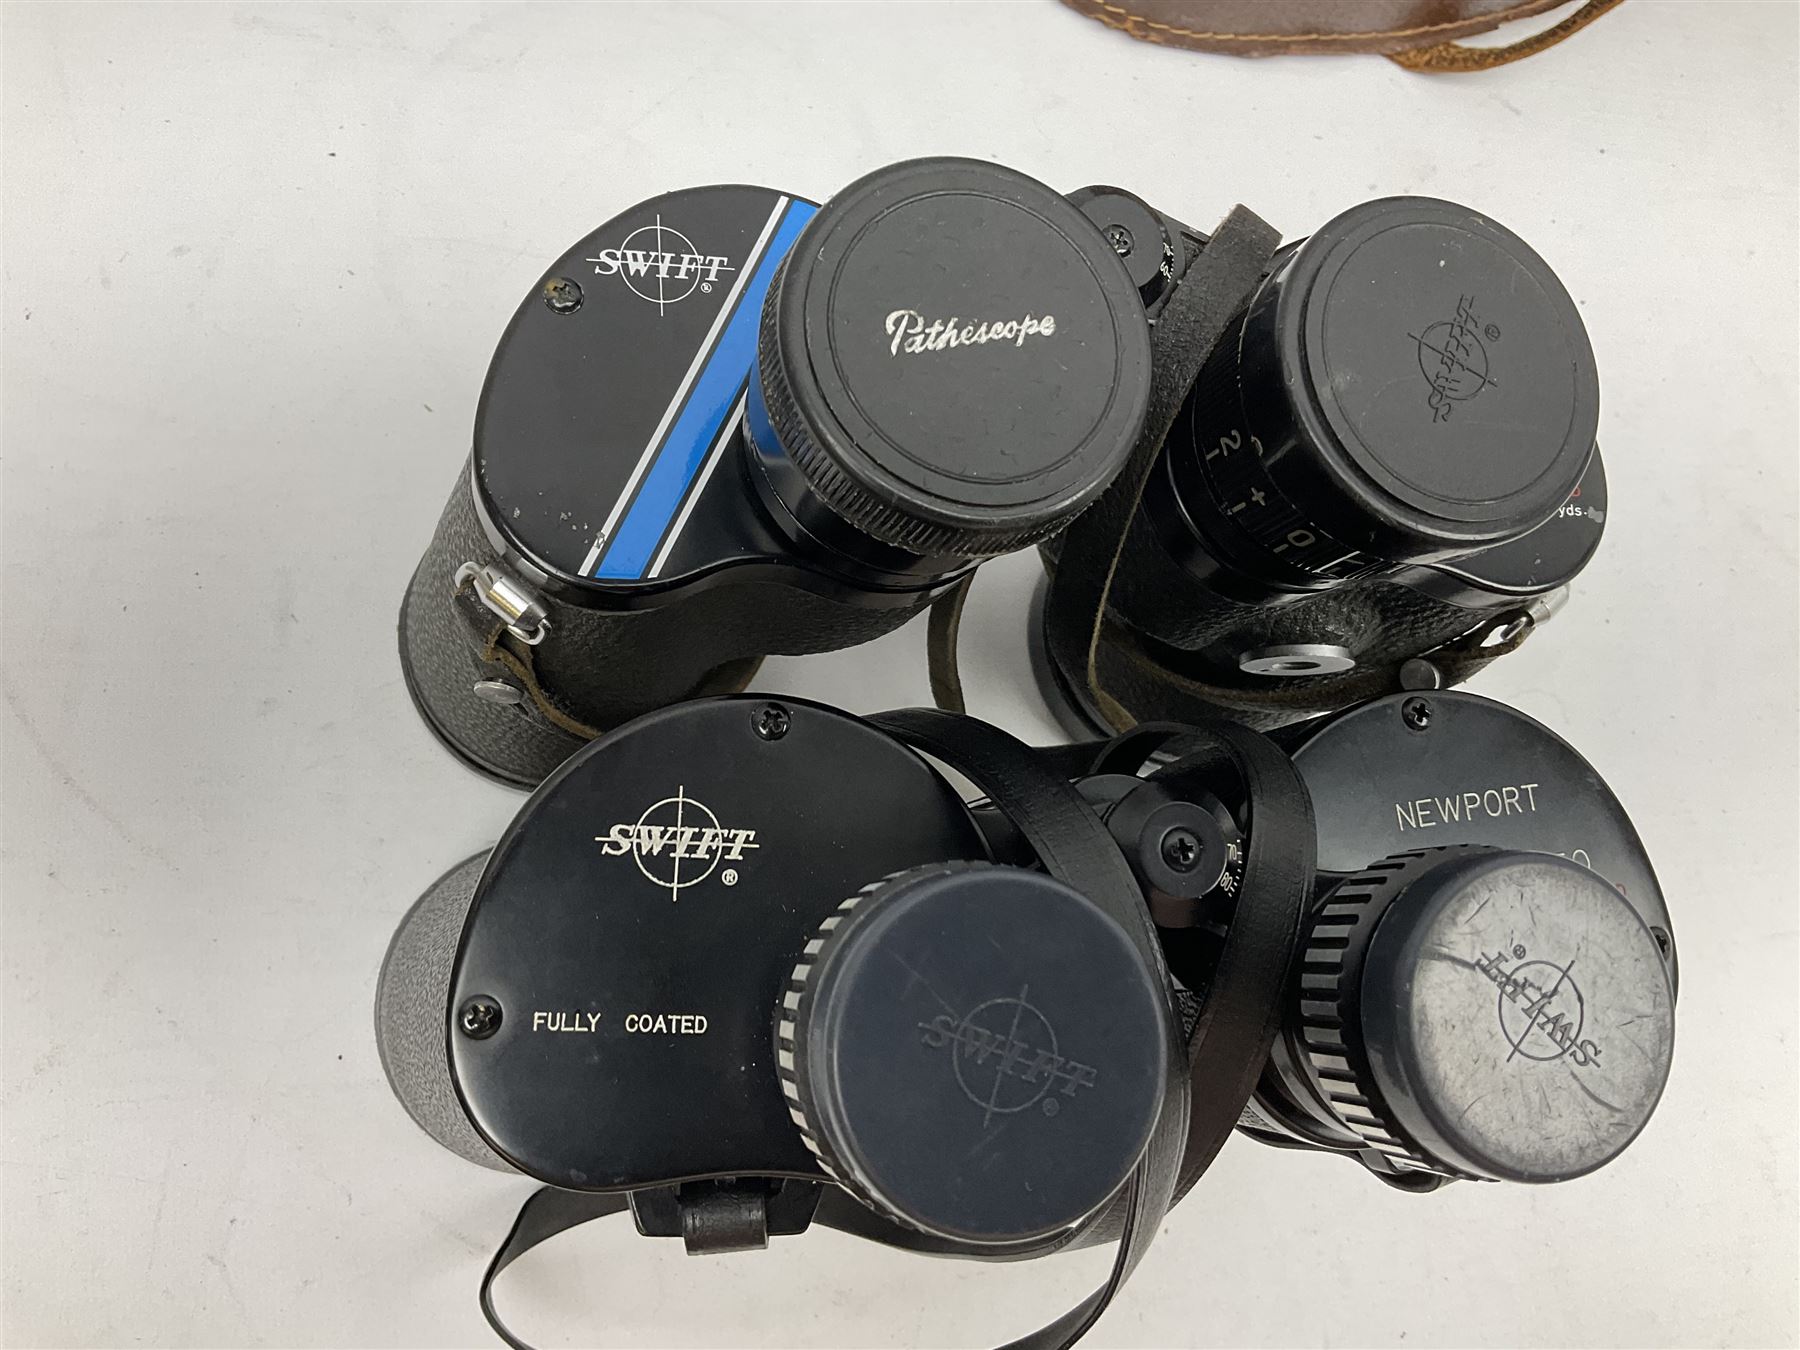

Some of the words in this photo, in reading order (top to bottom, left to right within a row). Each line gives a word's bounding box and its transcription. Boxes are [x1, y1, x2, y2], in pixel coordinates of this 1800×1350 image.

[594, 248, 729, 282] SWIFT
[1220, 429, 1242, 457] 2
[1395, 783, 1539, 832] NEWPORT
[601, 823, 756, 861] SWIFT
[532, 1011, 602, 1033] FULLY
[625, 1014, 709, 1035] COATED
[1474, 951, 1603, 1068] SWIFT
[920, 1014, 1098, 1097] SWIFT
